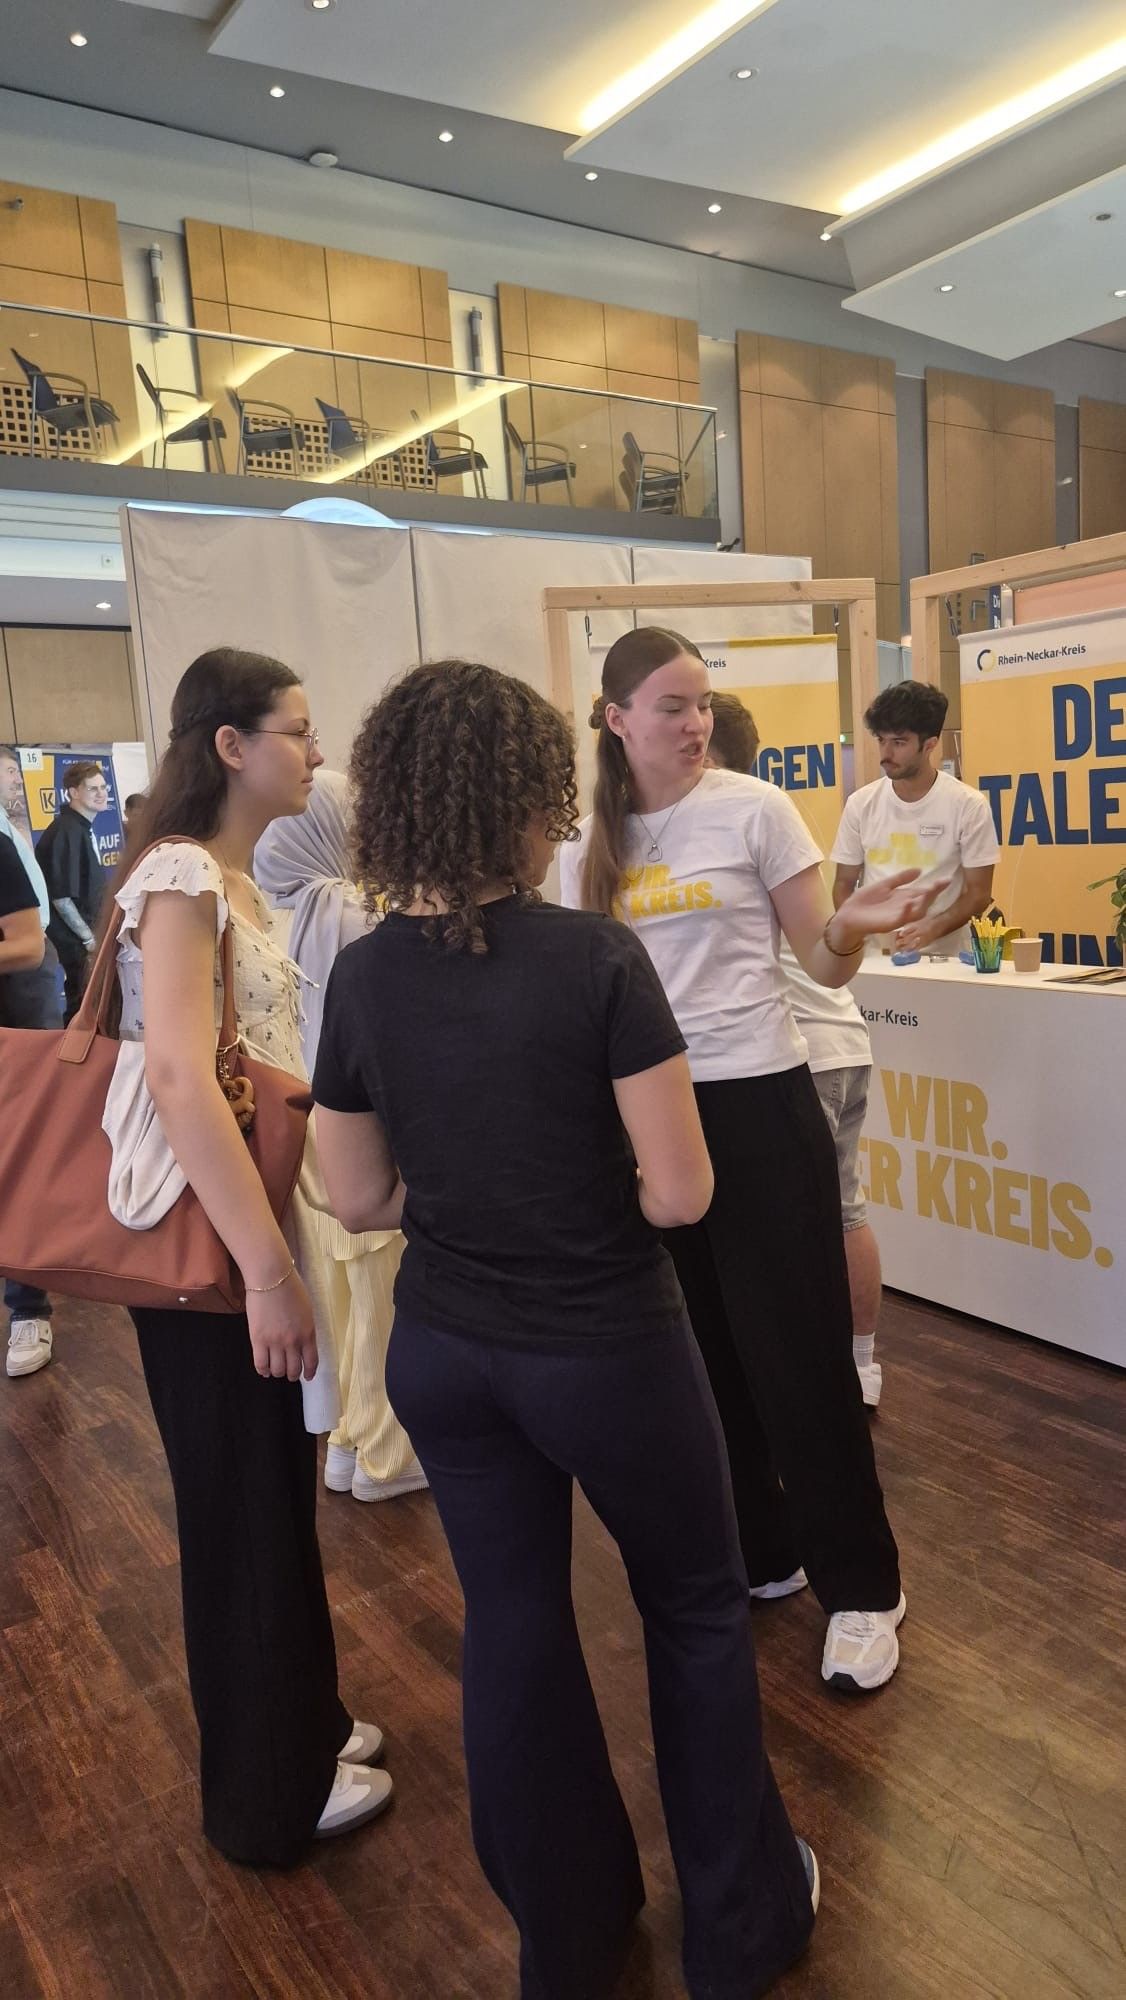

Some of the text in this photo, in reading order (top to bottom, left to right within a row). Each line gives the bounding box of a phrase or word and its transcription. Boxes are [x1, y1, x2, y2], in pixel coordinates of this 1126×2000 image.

[998, 644, 1087, 666] Rhein-Neckar-Kreis
[27, 753, 37, 763] 16
[751, 743, 836, 790] GEN
[978, 766, 1126, 846] TALE
[102, 850, 120, 867] GE
[880, 1069, 1008, 1160] WIR.
[916, 1150, 1113, 1268] KREIS.
